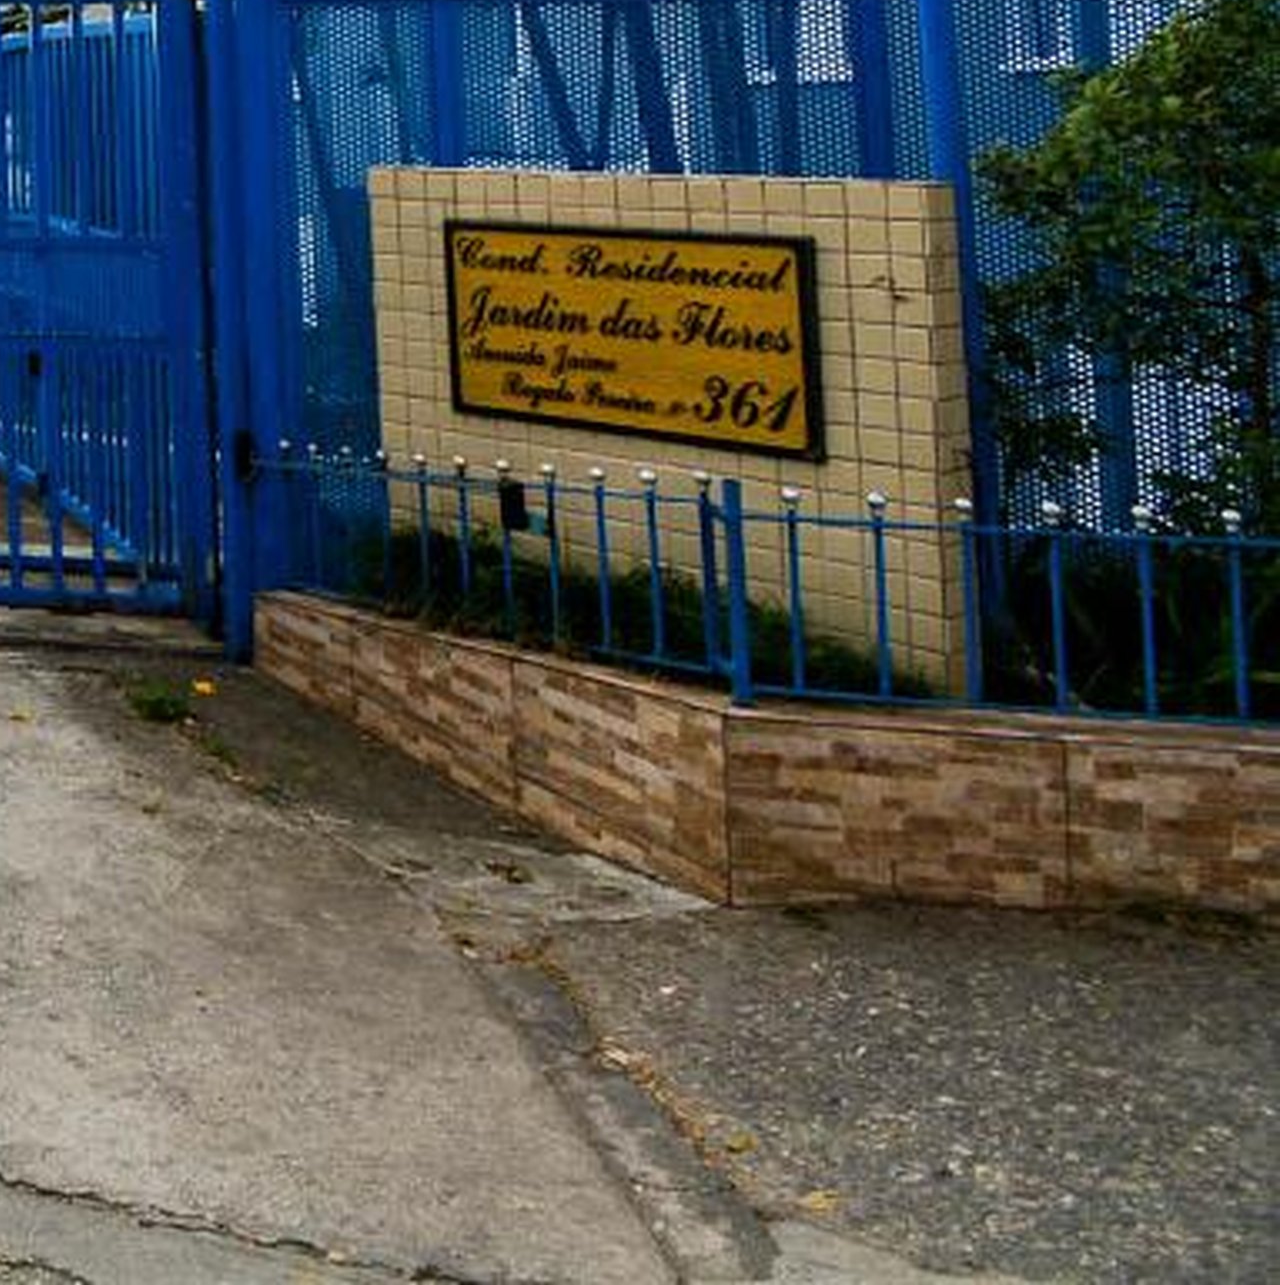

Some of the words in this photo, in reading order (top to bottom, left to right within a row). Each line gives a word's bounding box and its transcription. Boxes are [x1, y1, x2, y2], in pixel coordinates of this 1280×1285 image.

[456, 236, 548, 275] Cond.
[566, 244, 790, 293] Residencial
[461, 286, 588, 339] Jardim
[599, 299, 662, 341] das
[672, 302, 793, 354] Flores
[694, 376, 798, 432] 361
